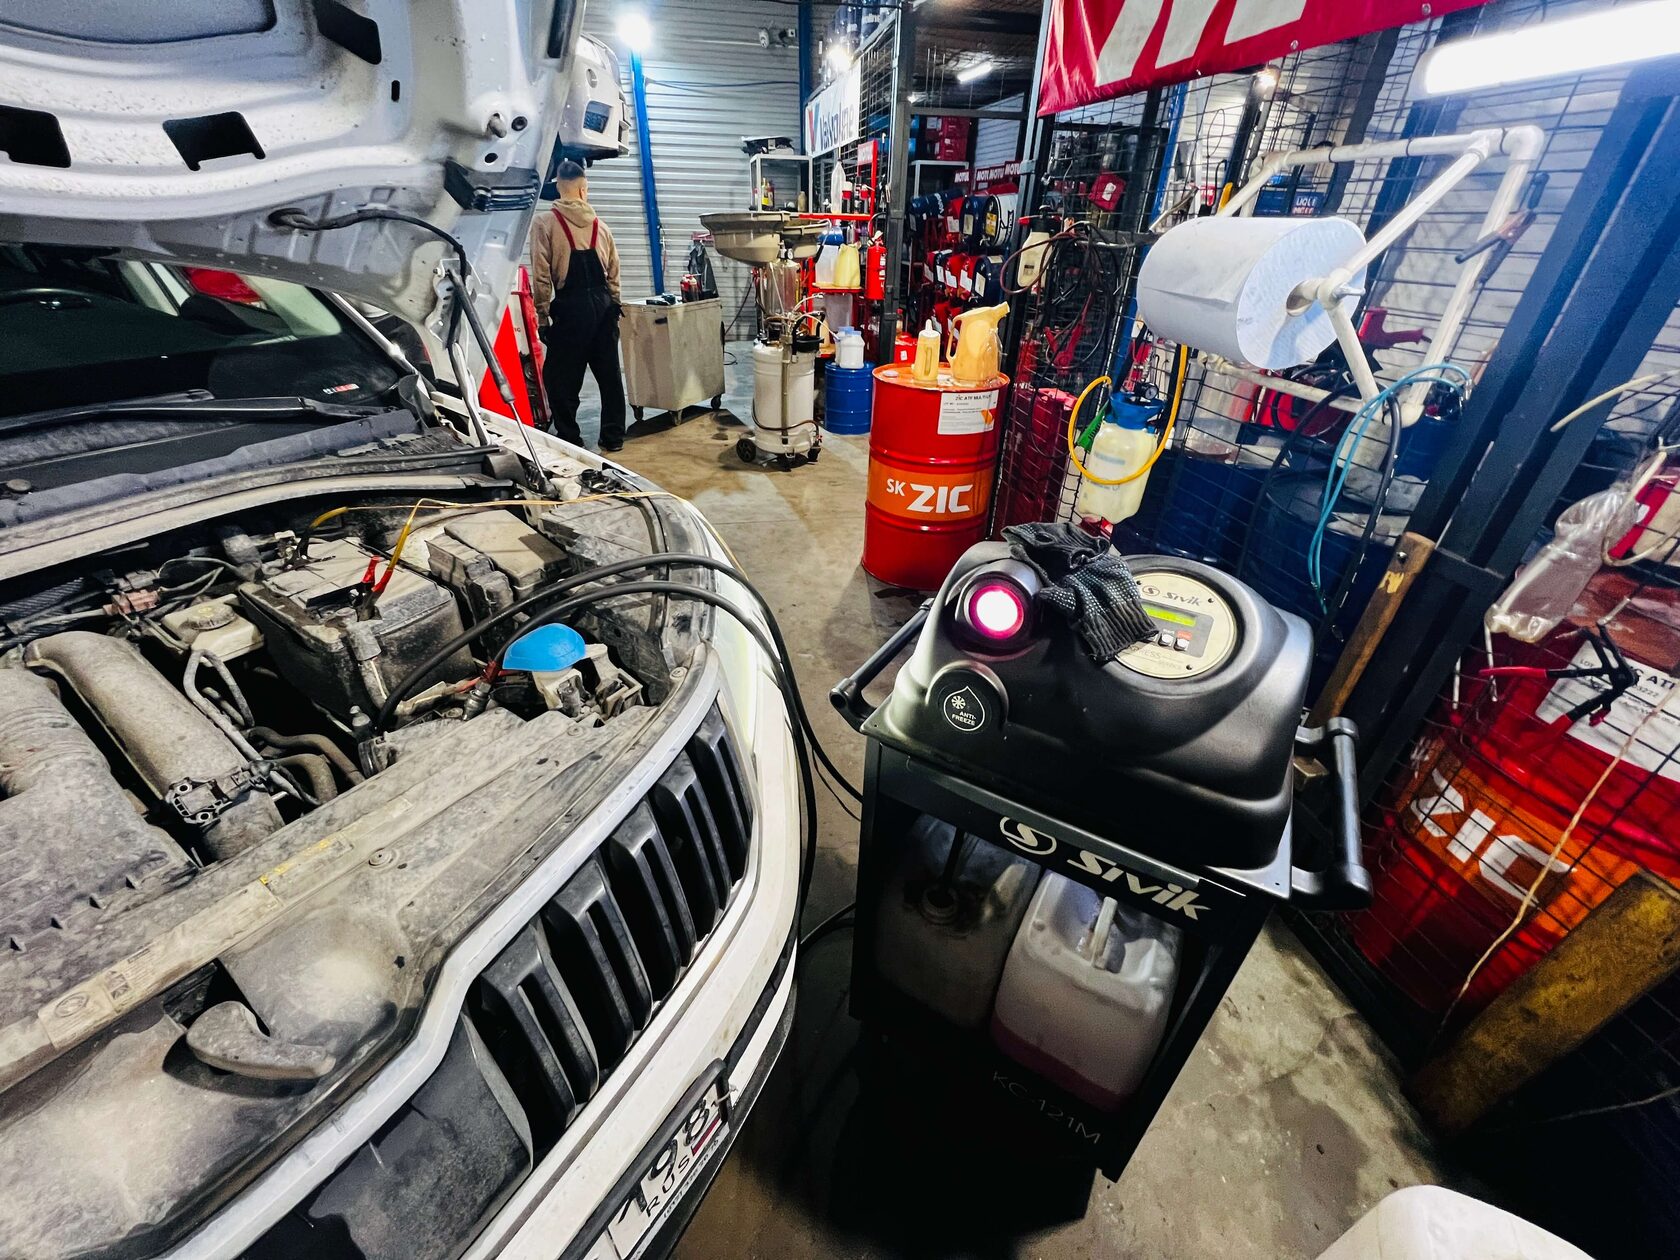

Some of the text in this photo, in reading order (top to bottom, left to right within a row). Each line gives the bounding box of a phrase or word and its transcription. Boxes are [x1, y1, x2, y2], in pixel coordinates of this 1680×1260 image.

[886, 478, 974, 514] SK ZIC
[951, 713, 976, 726] FREEZE
[959, 711, 977, 720] ANTI-
[1410, 768, 1578, 909] ZIC
[1066, 850, 1211, 921] Sivik
[645, 1154, 690, 1217] RUS
